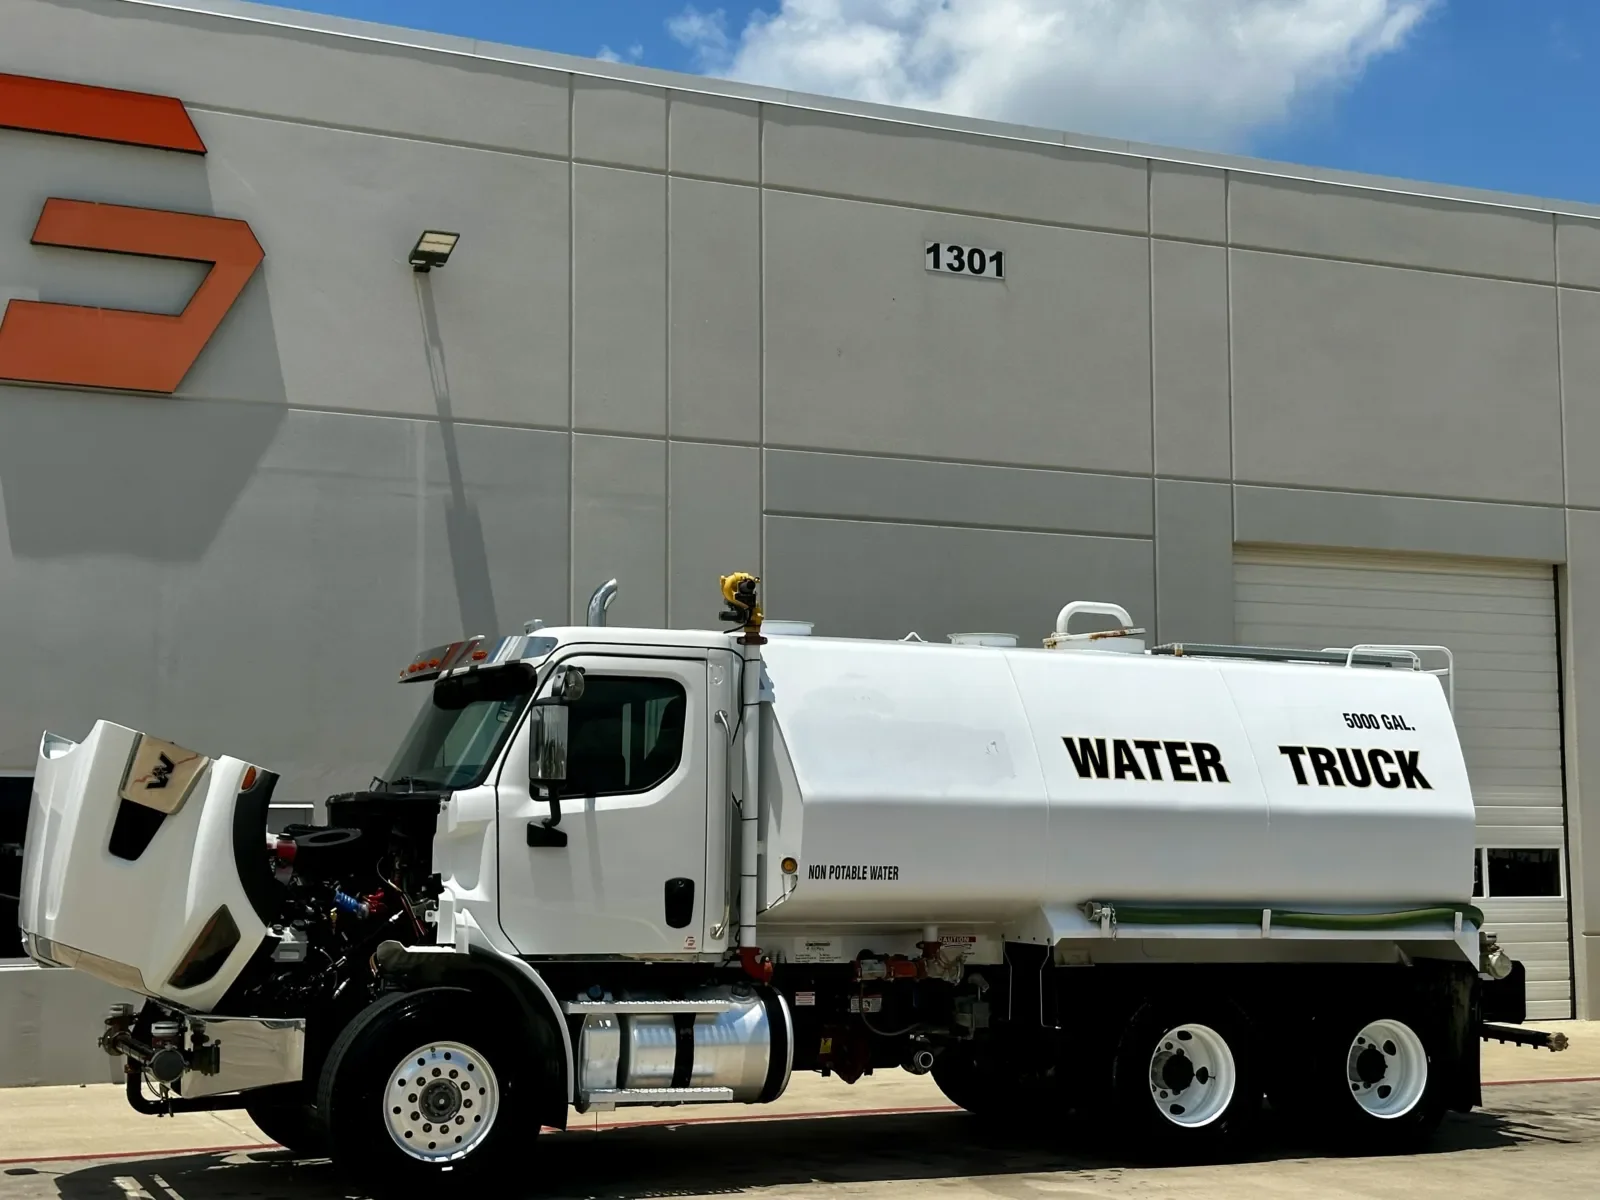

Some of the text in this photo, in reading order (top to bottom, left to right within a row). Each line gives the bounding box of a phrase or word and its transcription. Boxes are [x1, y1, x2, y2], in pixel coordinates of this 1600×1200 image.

[926, 242, 1003, 277] 1301
[1342, 712, 1416, 731] 5000 GAL.
[1061, 736, 1434, 791] WATER TRUCK
[808, 864, 899, 881] NON POTABLE WATER
[938, 935, 970, 943] CAUTION
